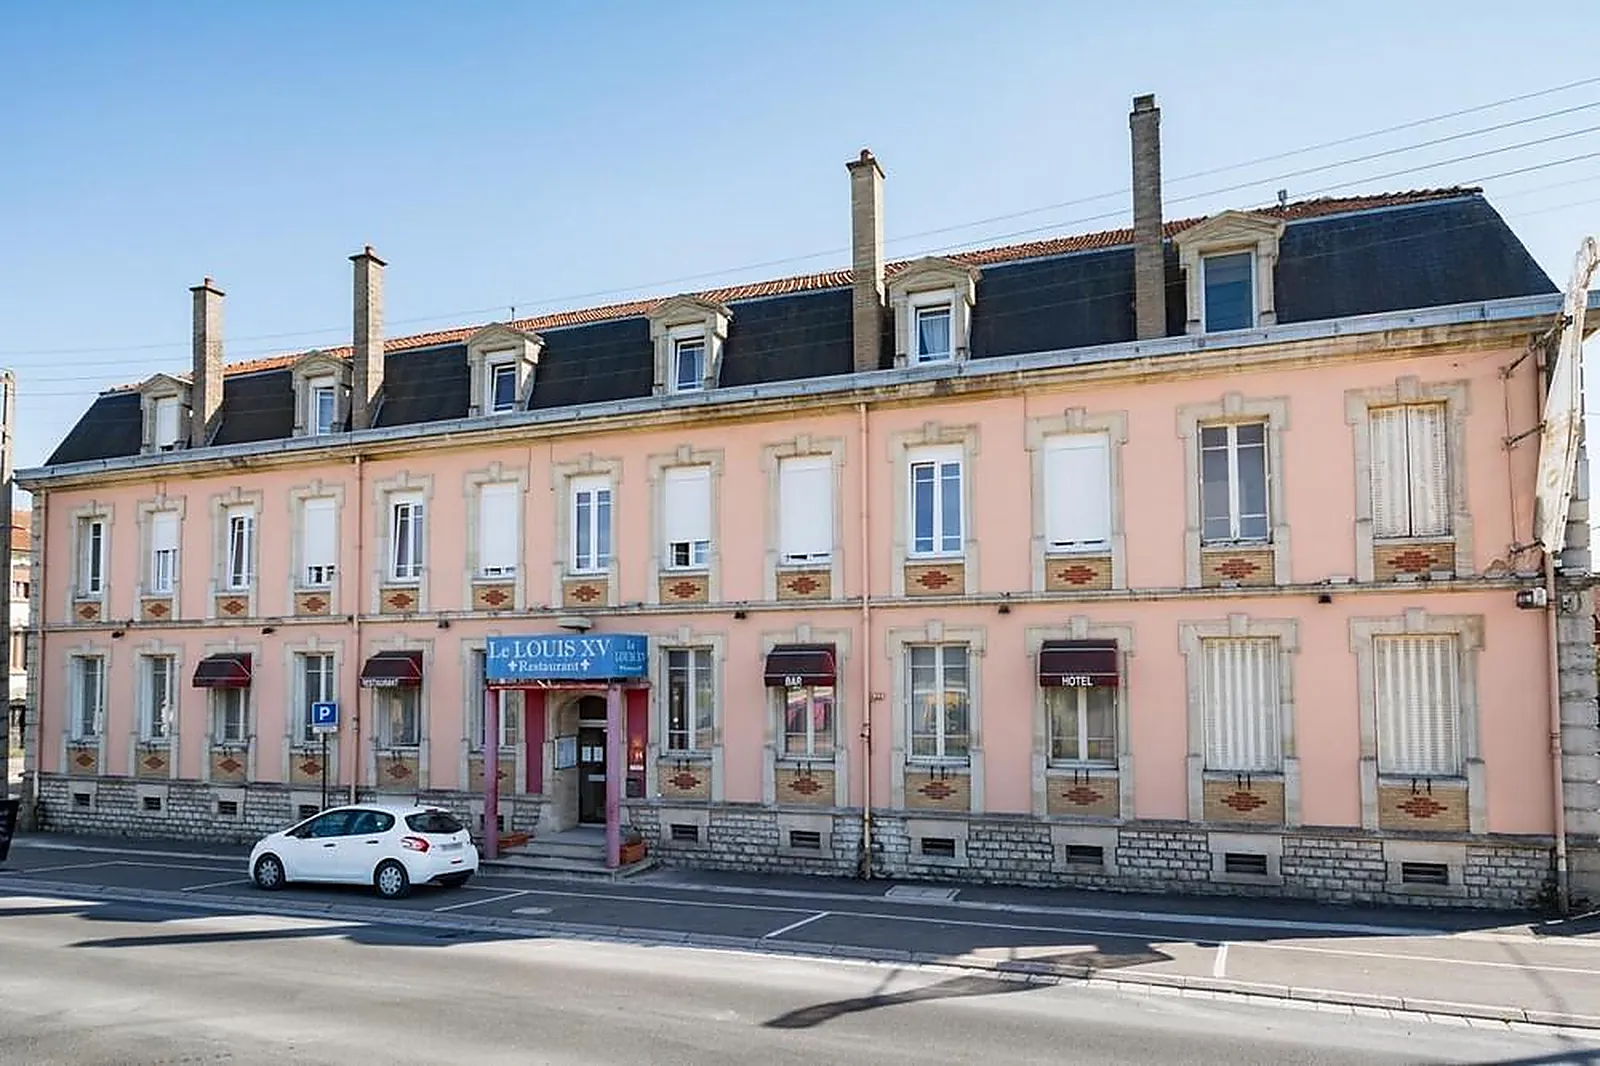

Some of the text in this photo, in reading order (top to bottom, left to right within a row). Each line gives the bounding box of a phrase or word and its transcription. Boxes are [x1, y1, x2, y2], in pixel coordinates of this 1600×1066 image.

[489, 639, 611, 658] Le LOUIS XV
[519, 660, 579, 672] Restaurant
[785, 676, 802, 686] BAR
[1061, 676, 1094, 686] HOTEL
[319, 706, 331, 720] P
